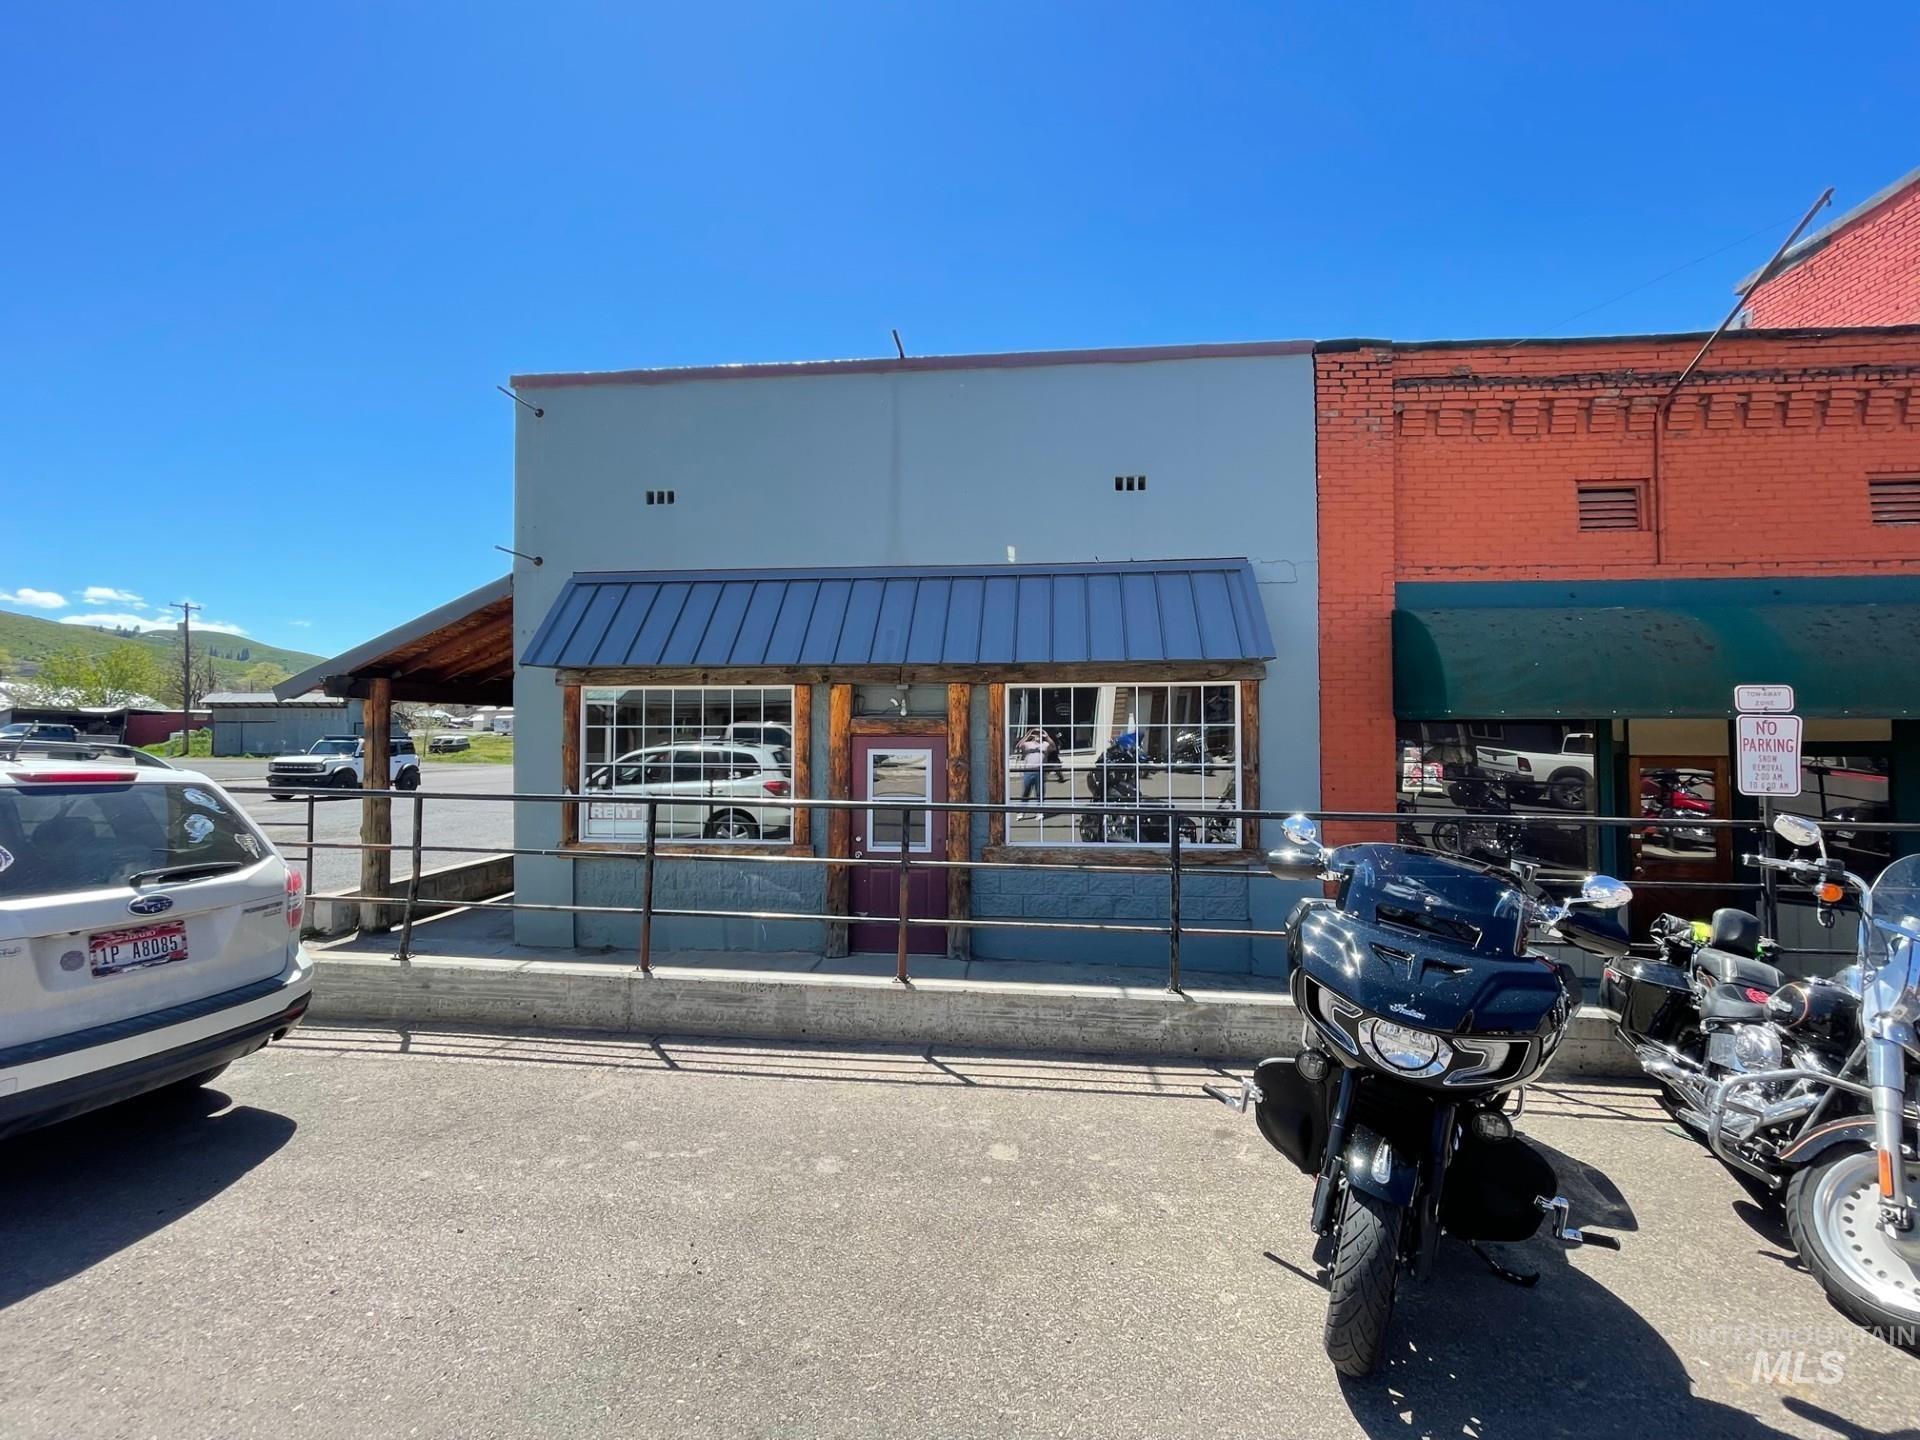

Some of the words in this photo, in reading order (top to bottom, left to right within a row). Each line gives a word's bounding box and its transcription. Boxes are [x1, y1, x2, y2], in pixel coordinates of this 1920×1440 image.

[1756, 721, 1777, 736] NO
[1743, 738, 1794, 753] PARKING
[1758, 755, 1777, 763] SNOW
[1752, 763, 1784, 772] REMOVAL
[1772, 773, 1783, 781] AM
[1780, 782, 1789, 790] AM
[591, 806, 641, 819] RENT
[101, 945, 120, 966] 1P
[133, 934, 179, 960] A8085
